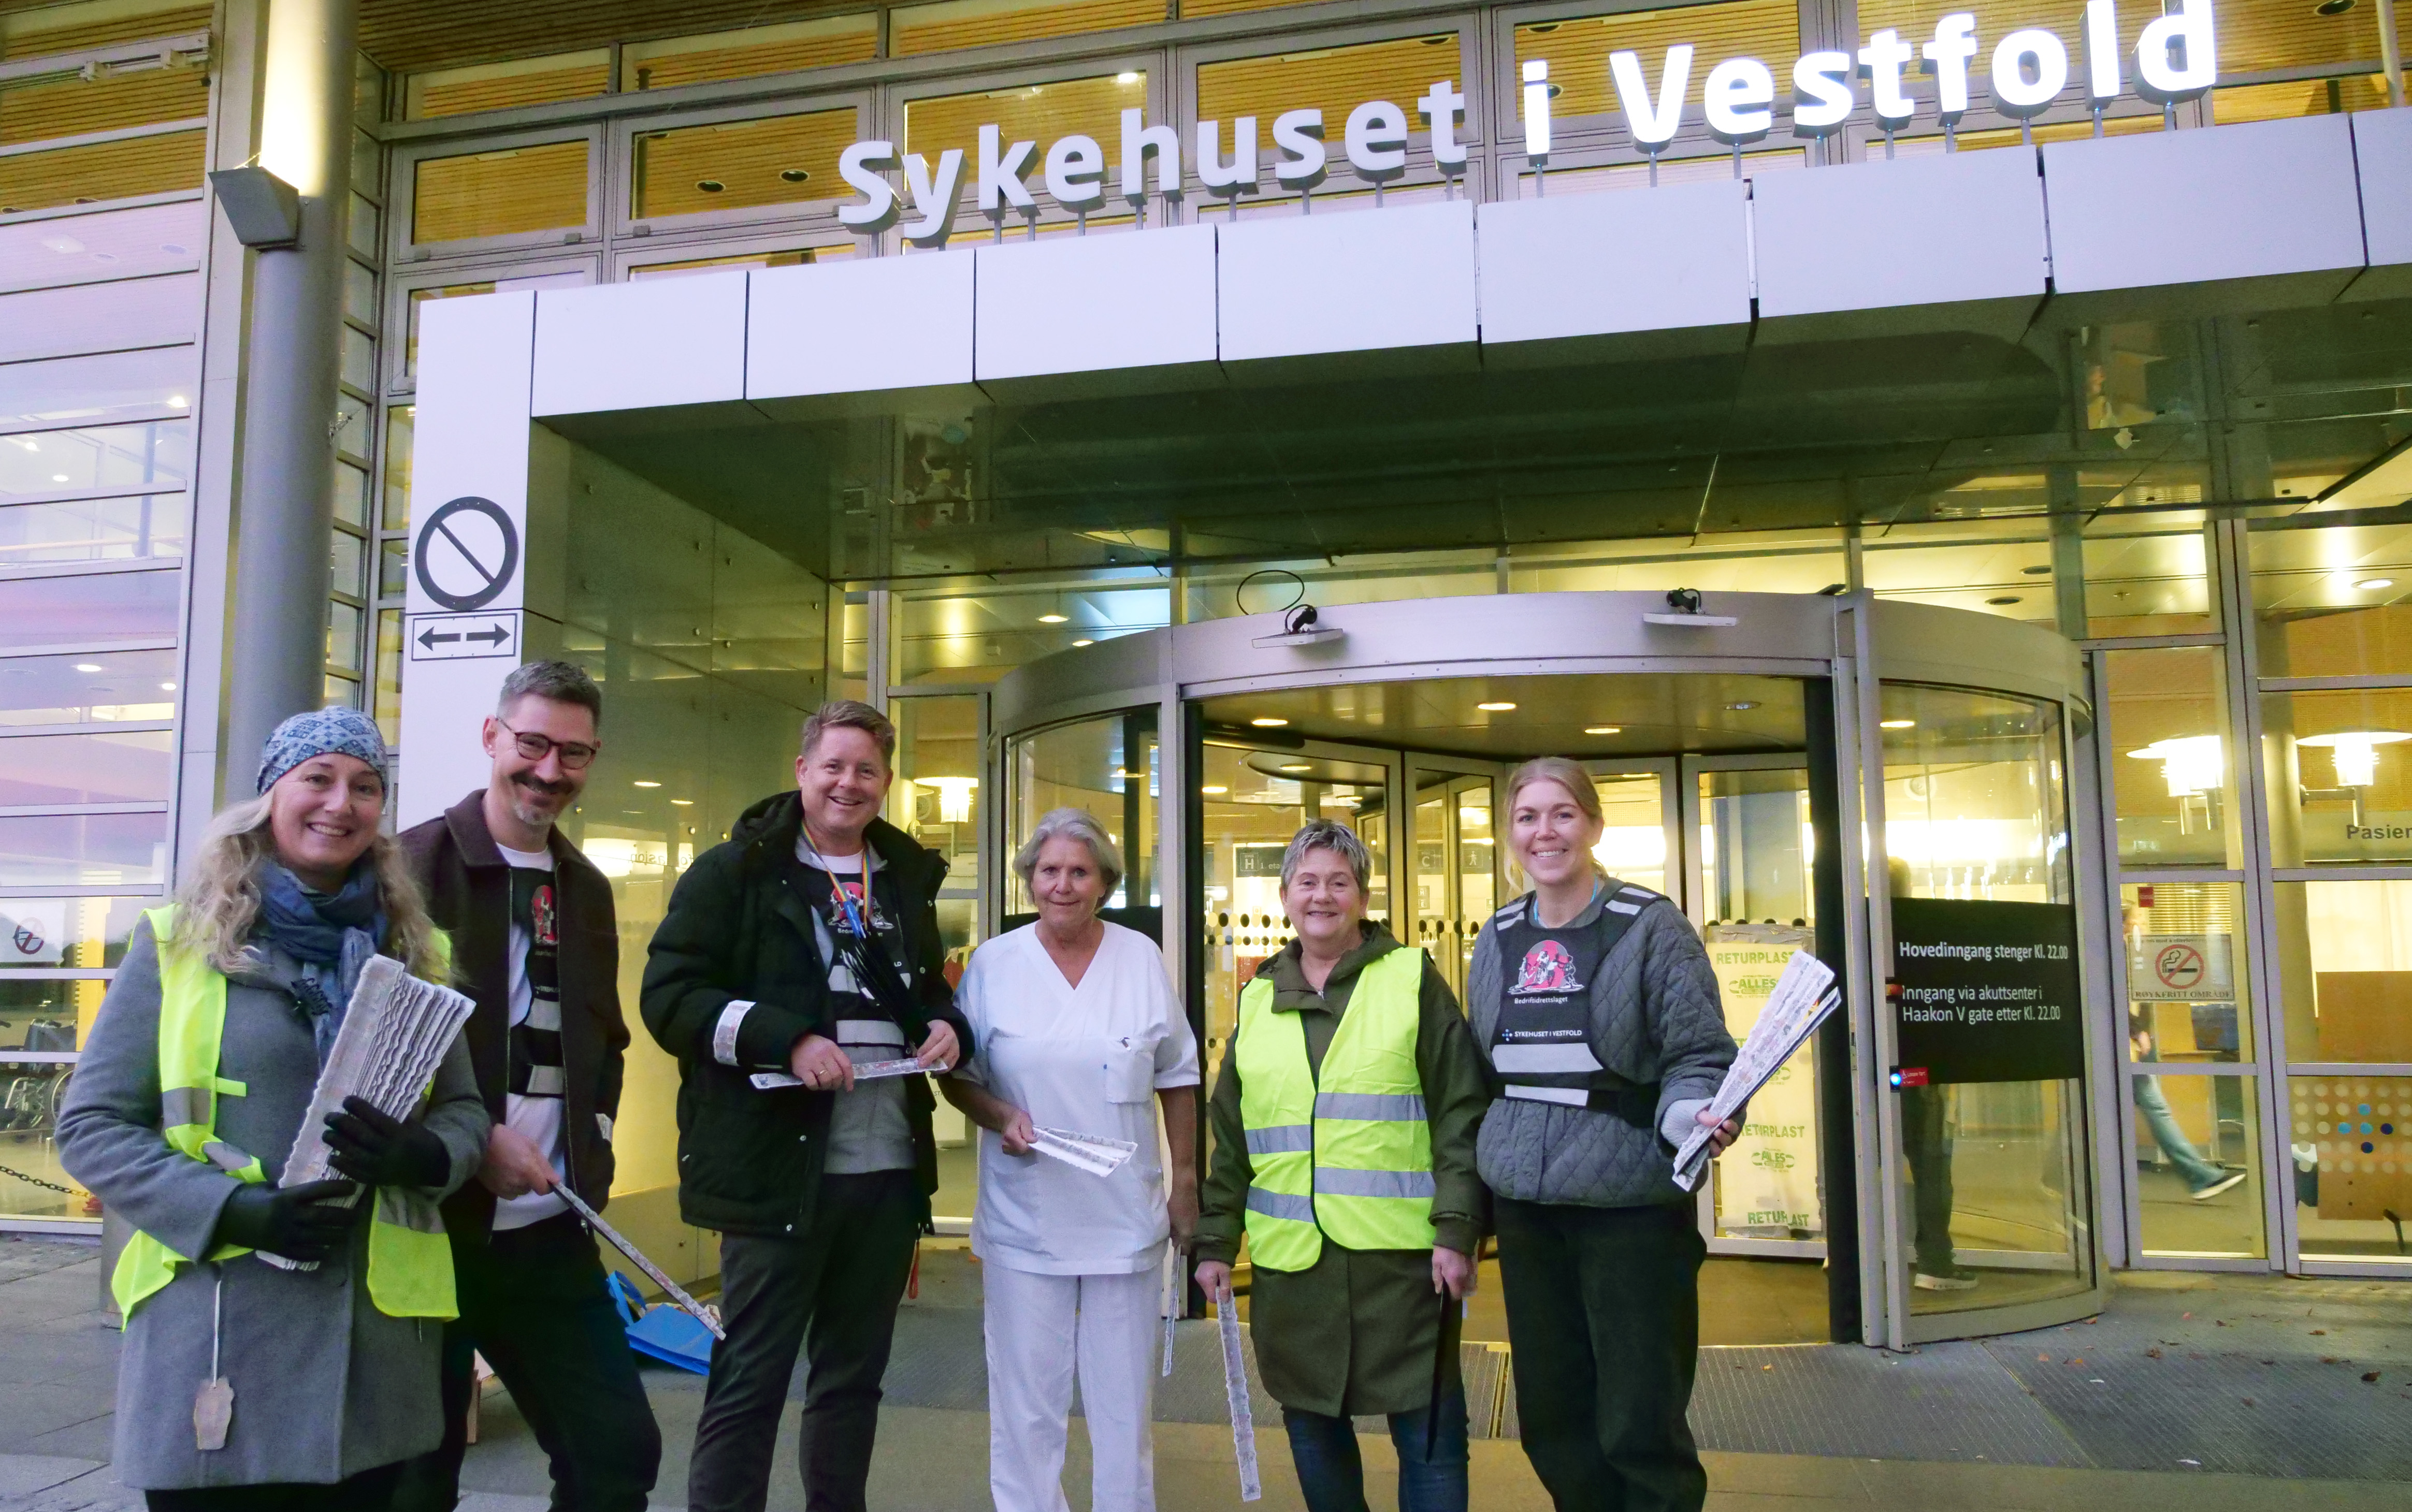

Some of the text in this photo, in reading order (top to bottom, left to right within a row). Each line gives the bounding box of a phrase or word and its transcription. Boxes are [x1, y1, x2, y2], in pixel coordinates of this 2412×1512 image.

[839, 0, 2217, 244] Sykehuset i Vestfold
[1245, 859, 1253, 869] H
[1422, 856, 1429, 866] C
[1900, 942, 2068, 962] Hovedinngang stenger Kl. 22.00
[1514, 996, 1568, 1004] Bedriftidrettslaget
[1902, 985, 2042, 1004] Inngang via akuttsenter i
[1903, 1006, 2060, 1024] Haakon V gate etter Kl. 22.00
